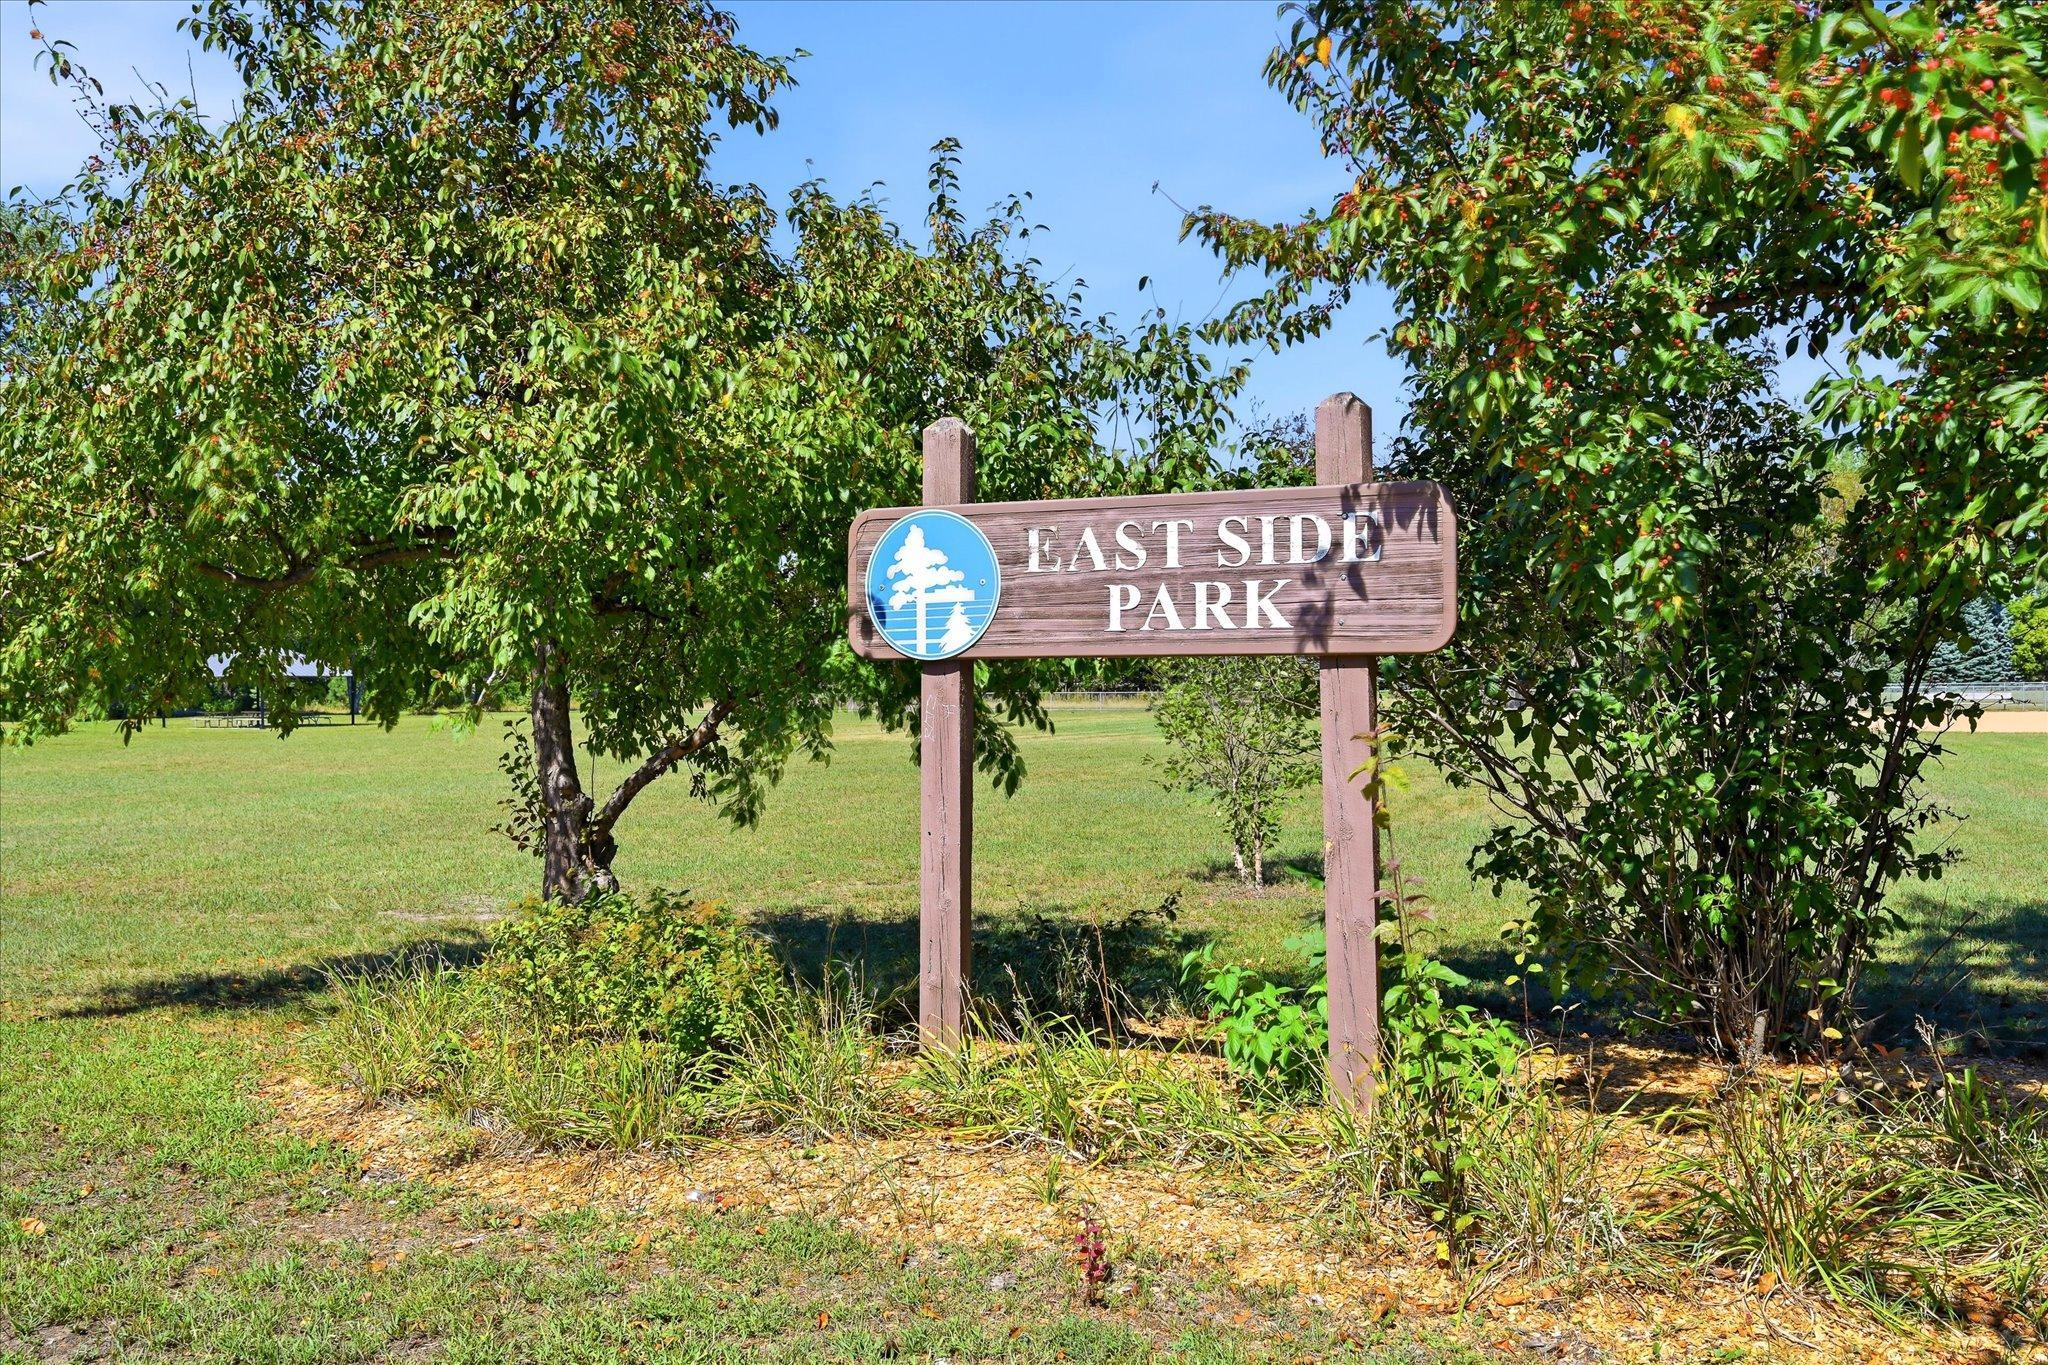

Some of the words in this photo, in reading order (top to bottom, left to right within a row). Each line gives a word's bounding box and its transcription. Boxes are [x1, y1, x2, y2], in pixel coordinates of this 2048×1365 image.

[1024, 520, 1193, 573] EAST
[1217, 511, 1382, 568] SIDE
[1104, 579, 1295, 632] PARK
